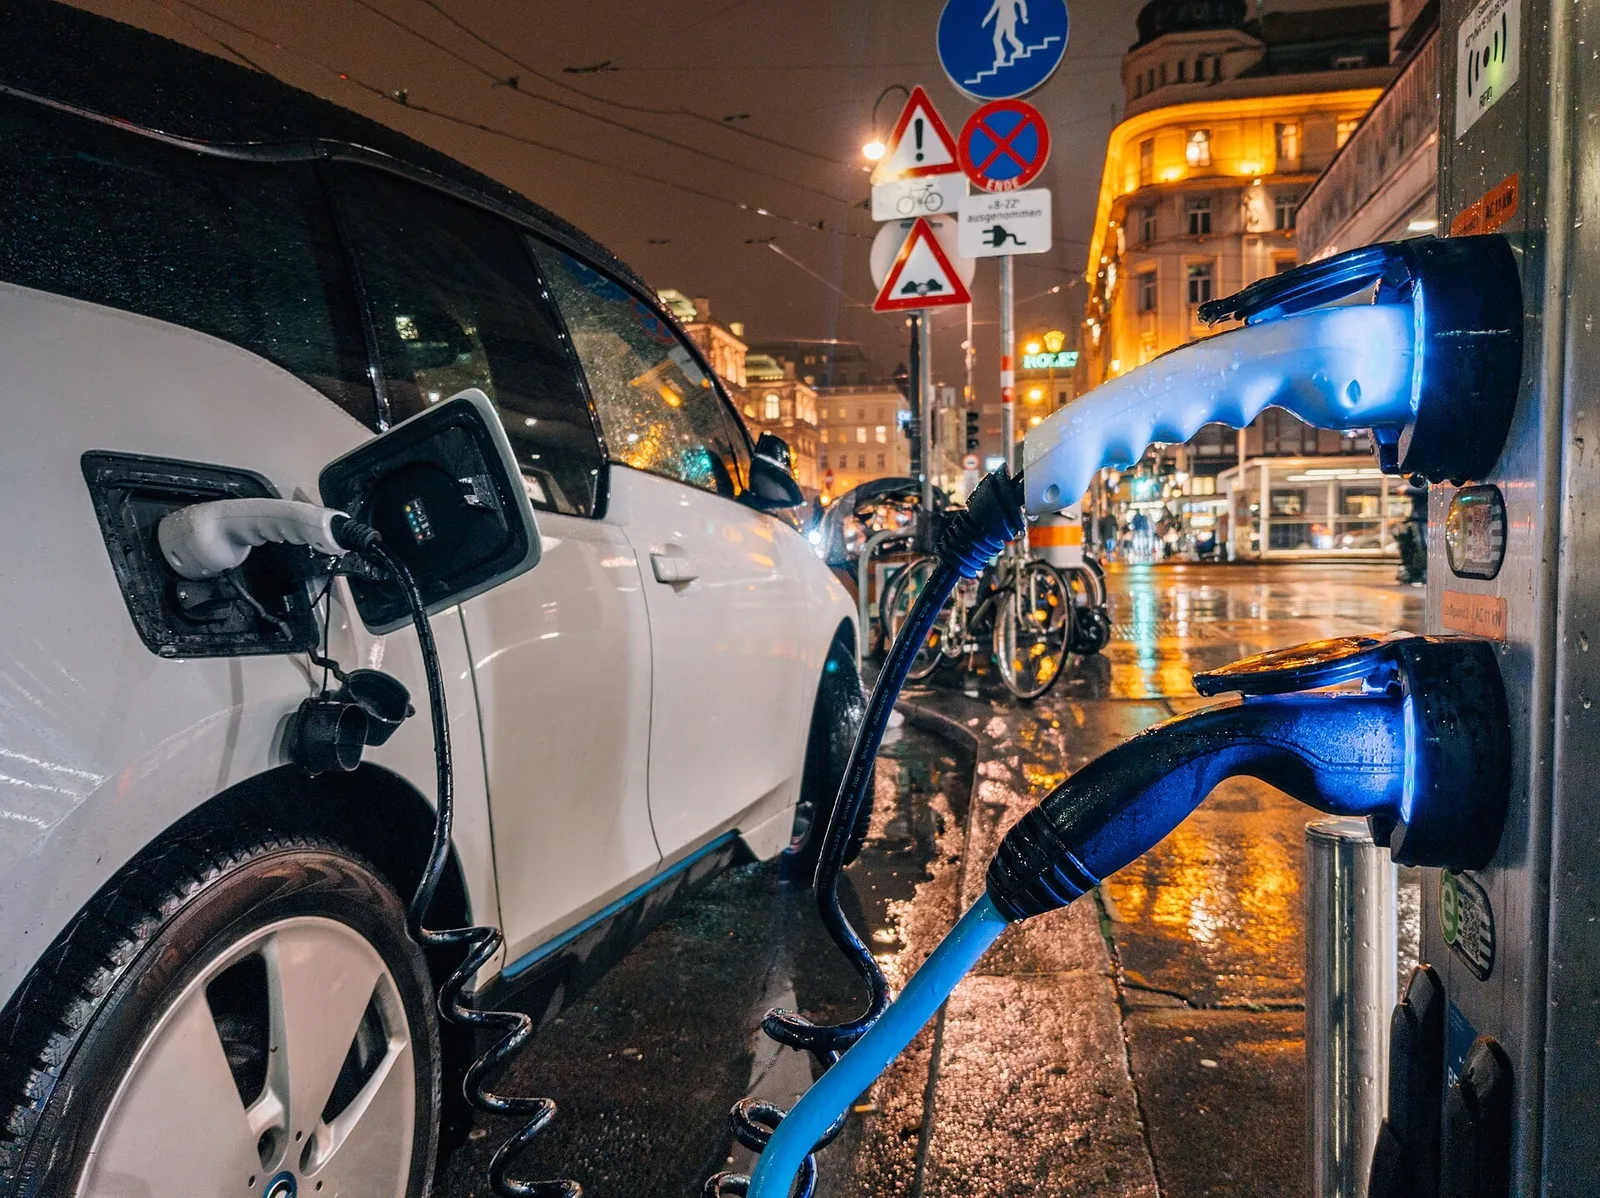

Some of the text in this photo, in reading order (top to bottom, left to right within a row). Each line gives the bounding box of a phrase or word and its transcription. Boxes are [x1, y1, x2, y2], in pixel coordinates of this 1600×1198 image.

[985, 177, 1021, 192] ENDE
[967, 209, 1043, 223] ausgenommen
[861, 732, 874, 760] CHANG
[852, 766, 863, 788] ZHOU
